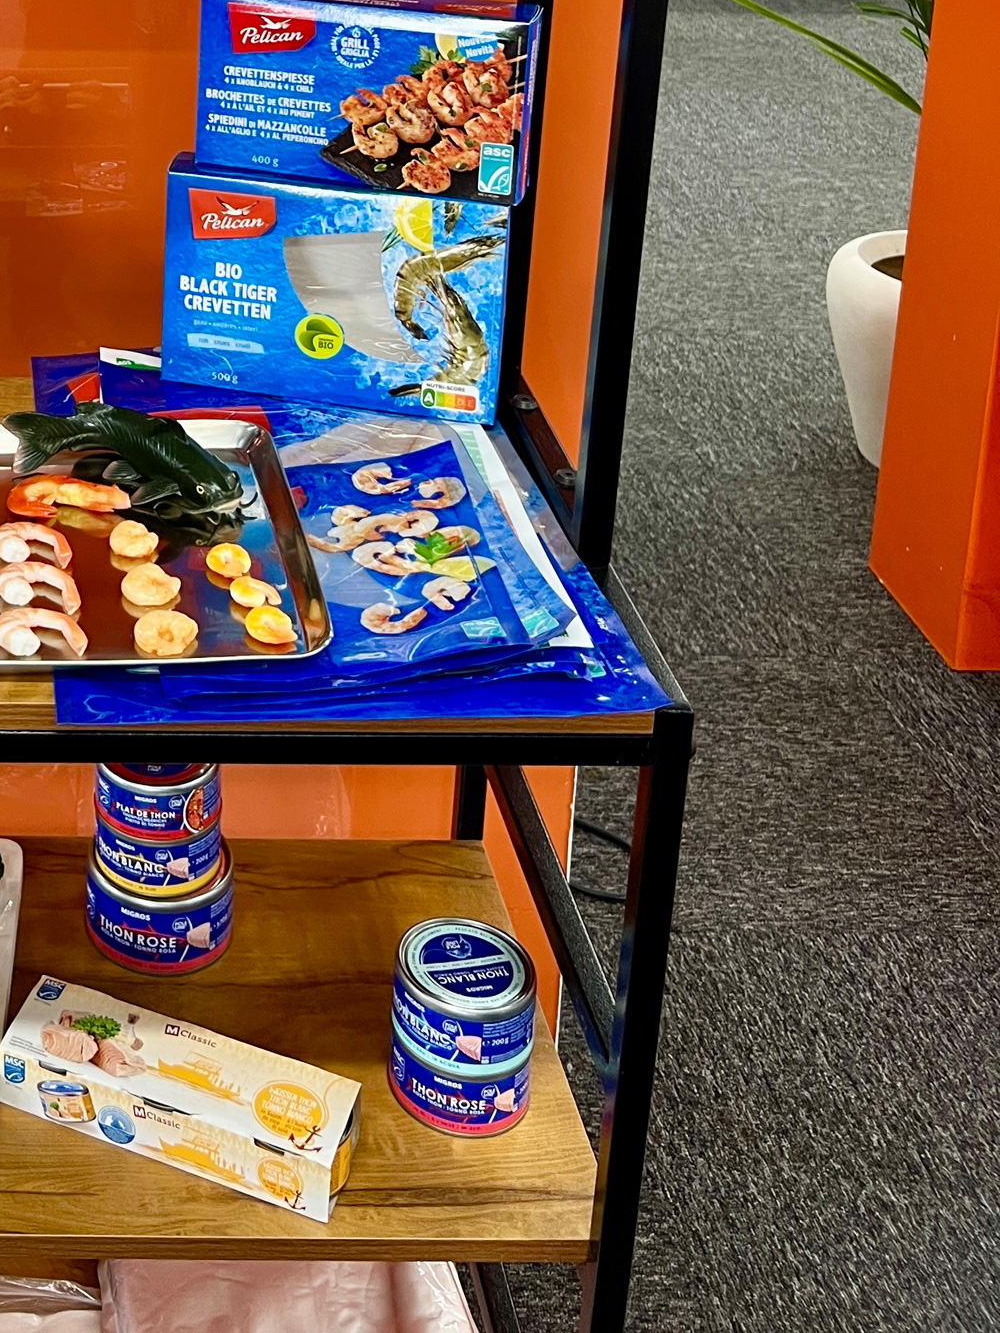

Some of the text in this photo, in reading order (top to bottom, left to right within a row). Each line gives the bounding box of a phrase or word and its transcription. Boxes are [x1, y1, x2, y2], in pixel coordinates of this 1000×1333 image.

[240, 27, 303, 44] Pelican
[341, 37, 369, 49] GRILL
[466, 45, 494, 58] Novità
[224, 66, 315, 85] CREVETTENSPIESSE
[206, 89, 265, 104] BROCHETTES
[278, 97, 331, 112] CREVETTES
[208, 114, 326, 137] SPIEDINI MAZZANCOLLE
[252, 155, 271, 164] 400
[484, 148, 510, 157] asc
[201, 214, 264, 230] Pelican
[215, 262, 242, 279] BIO
[180, 275, 277, 302] BLACK TIGER
[184, 294, 271, 320] CREVETTEN
[212, 372, 231, 380] 500
[427, 384, 465, 392] NUTRI-SCORE
[116, 802, 134, 816] PLAT
[137, 810, 148, 818] DE
[121, 857, 164, 874] BLANC
[121, 907, 151, 921] MIGROS
[100, 914, 176, 948] THON ROSE
[45, 980, 64, 989] MSC
[167, 1026, 217, 1048] M Classic
[5, 1055, 25, 1068] MSC
[434, 1076, 462, 1089] MIGROS
[412, 1078, 486, 1111] THON ROSE
[135, 1108, 181, 1130] M Classic
